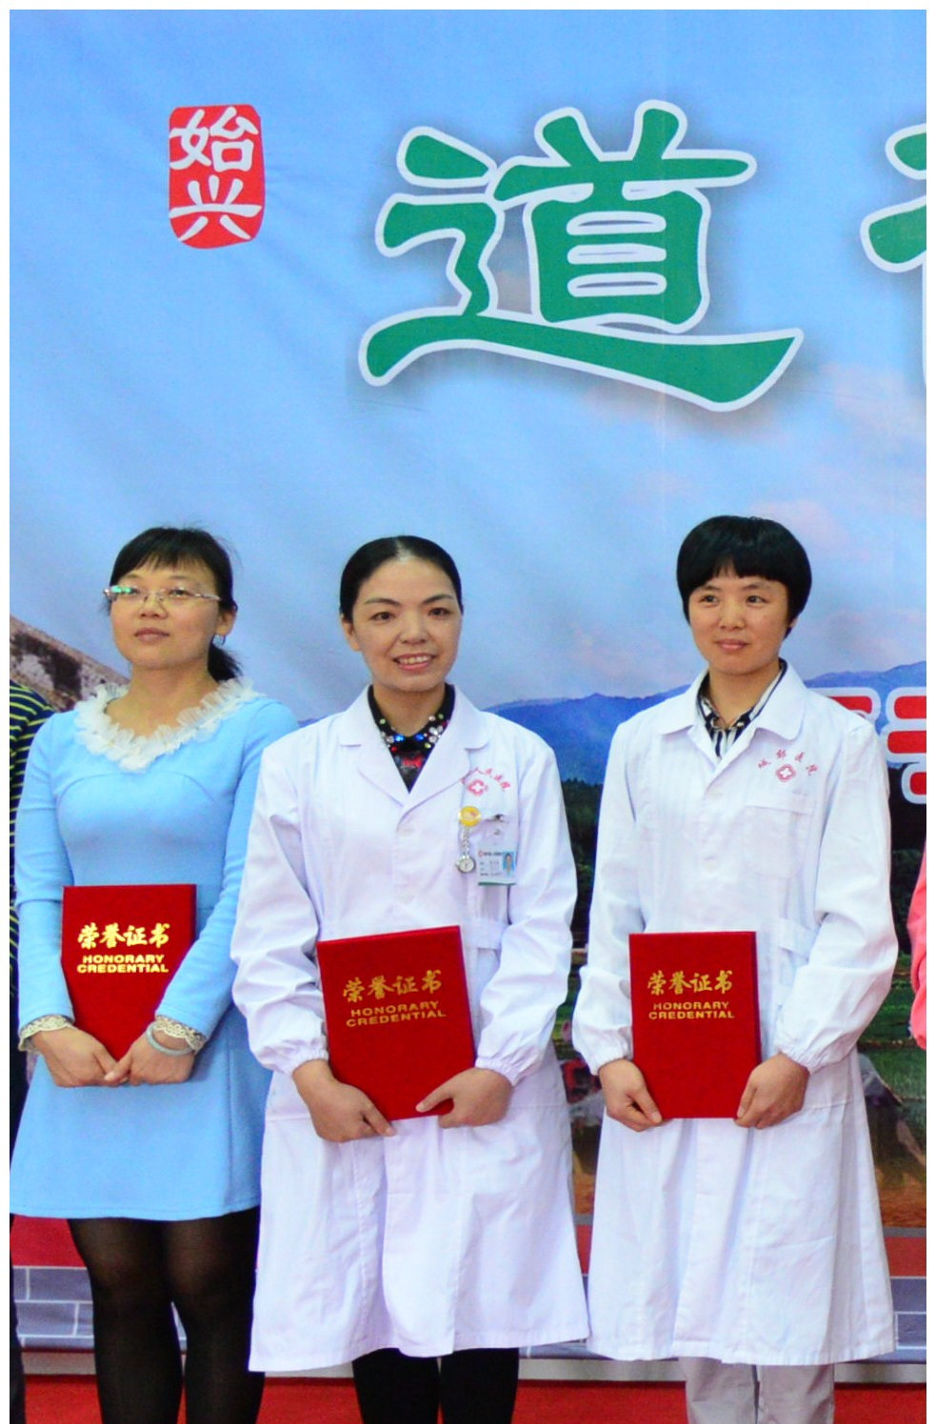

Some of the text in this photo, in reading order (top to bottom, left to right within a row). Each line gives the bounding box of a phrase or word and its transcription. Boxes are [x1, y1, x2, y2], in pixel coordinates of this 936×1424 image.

[169, 106, 260, 242] 始兴
[359, 99, 927, 411] 道
[77, 922, 170, 950] 荣誉证书
[82, 954, 165, 964] HONORARY
[77, 963, 169, 973] CREDENTIAL
[342, 969, 442, 1003] 荣誉证书
[647, 970, 733, 996] 荣誉证书
[351, 1000, 439, 1017] HONORARY
[653, 1001, 729, 1011] HONORARY
[346, 1010, 446, 1027] CREDENTIAL
[648, 1010, 735, 1020] CREDENTIAL
